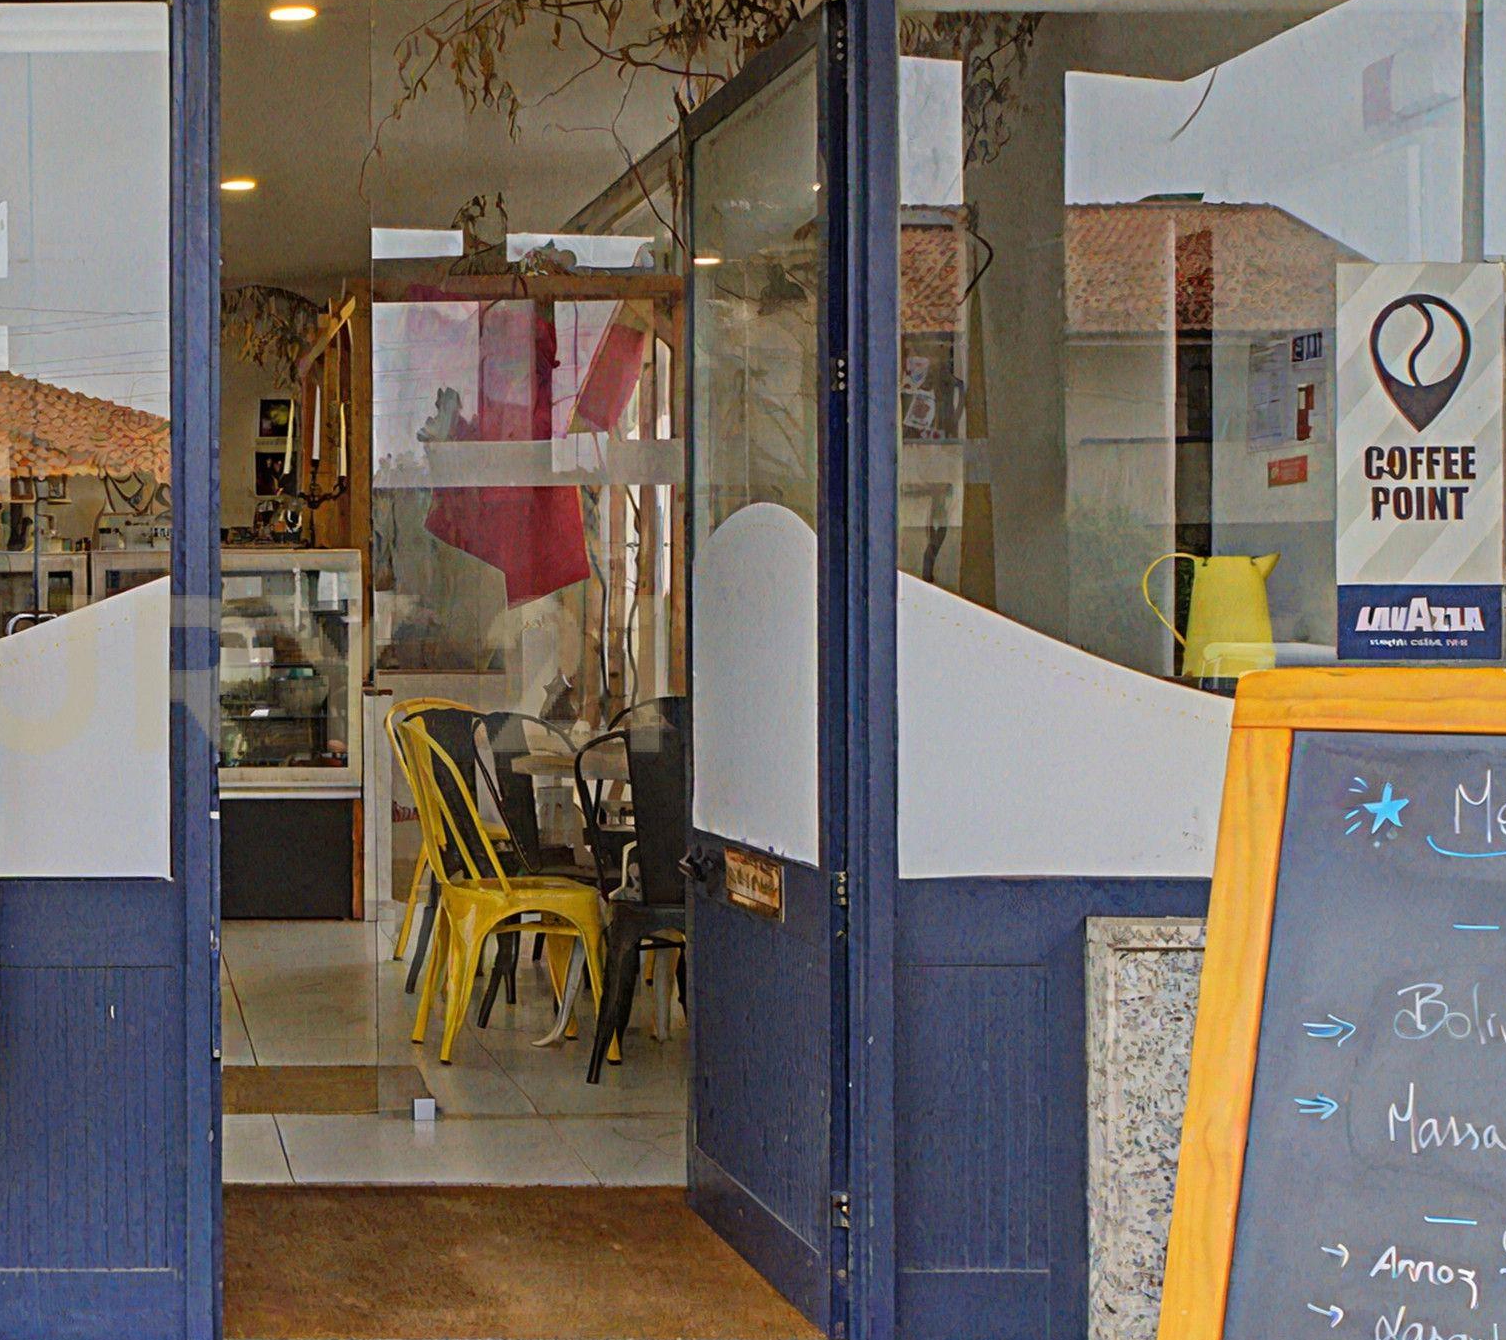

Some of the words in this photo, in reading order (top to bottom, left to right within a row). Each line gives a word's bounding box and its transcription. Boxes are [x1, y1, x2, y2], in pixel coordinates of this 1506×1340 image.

[1364, 445, 1477, 480] COFFEE
[1371, 486, 1470, 522] POINT
[1354, 596, 1486, 632] LAVAZZA
[1368, 1245, 1480, 1311] Arroz
